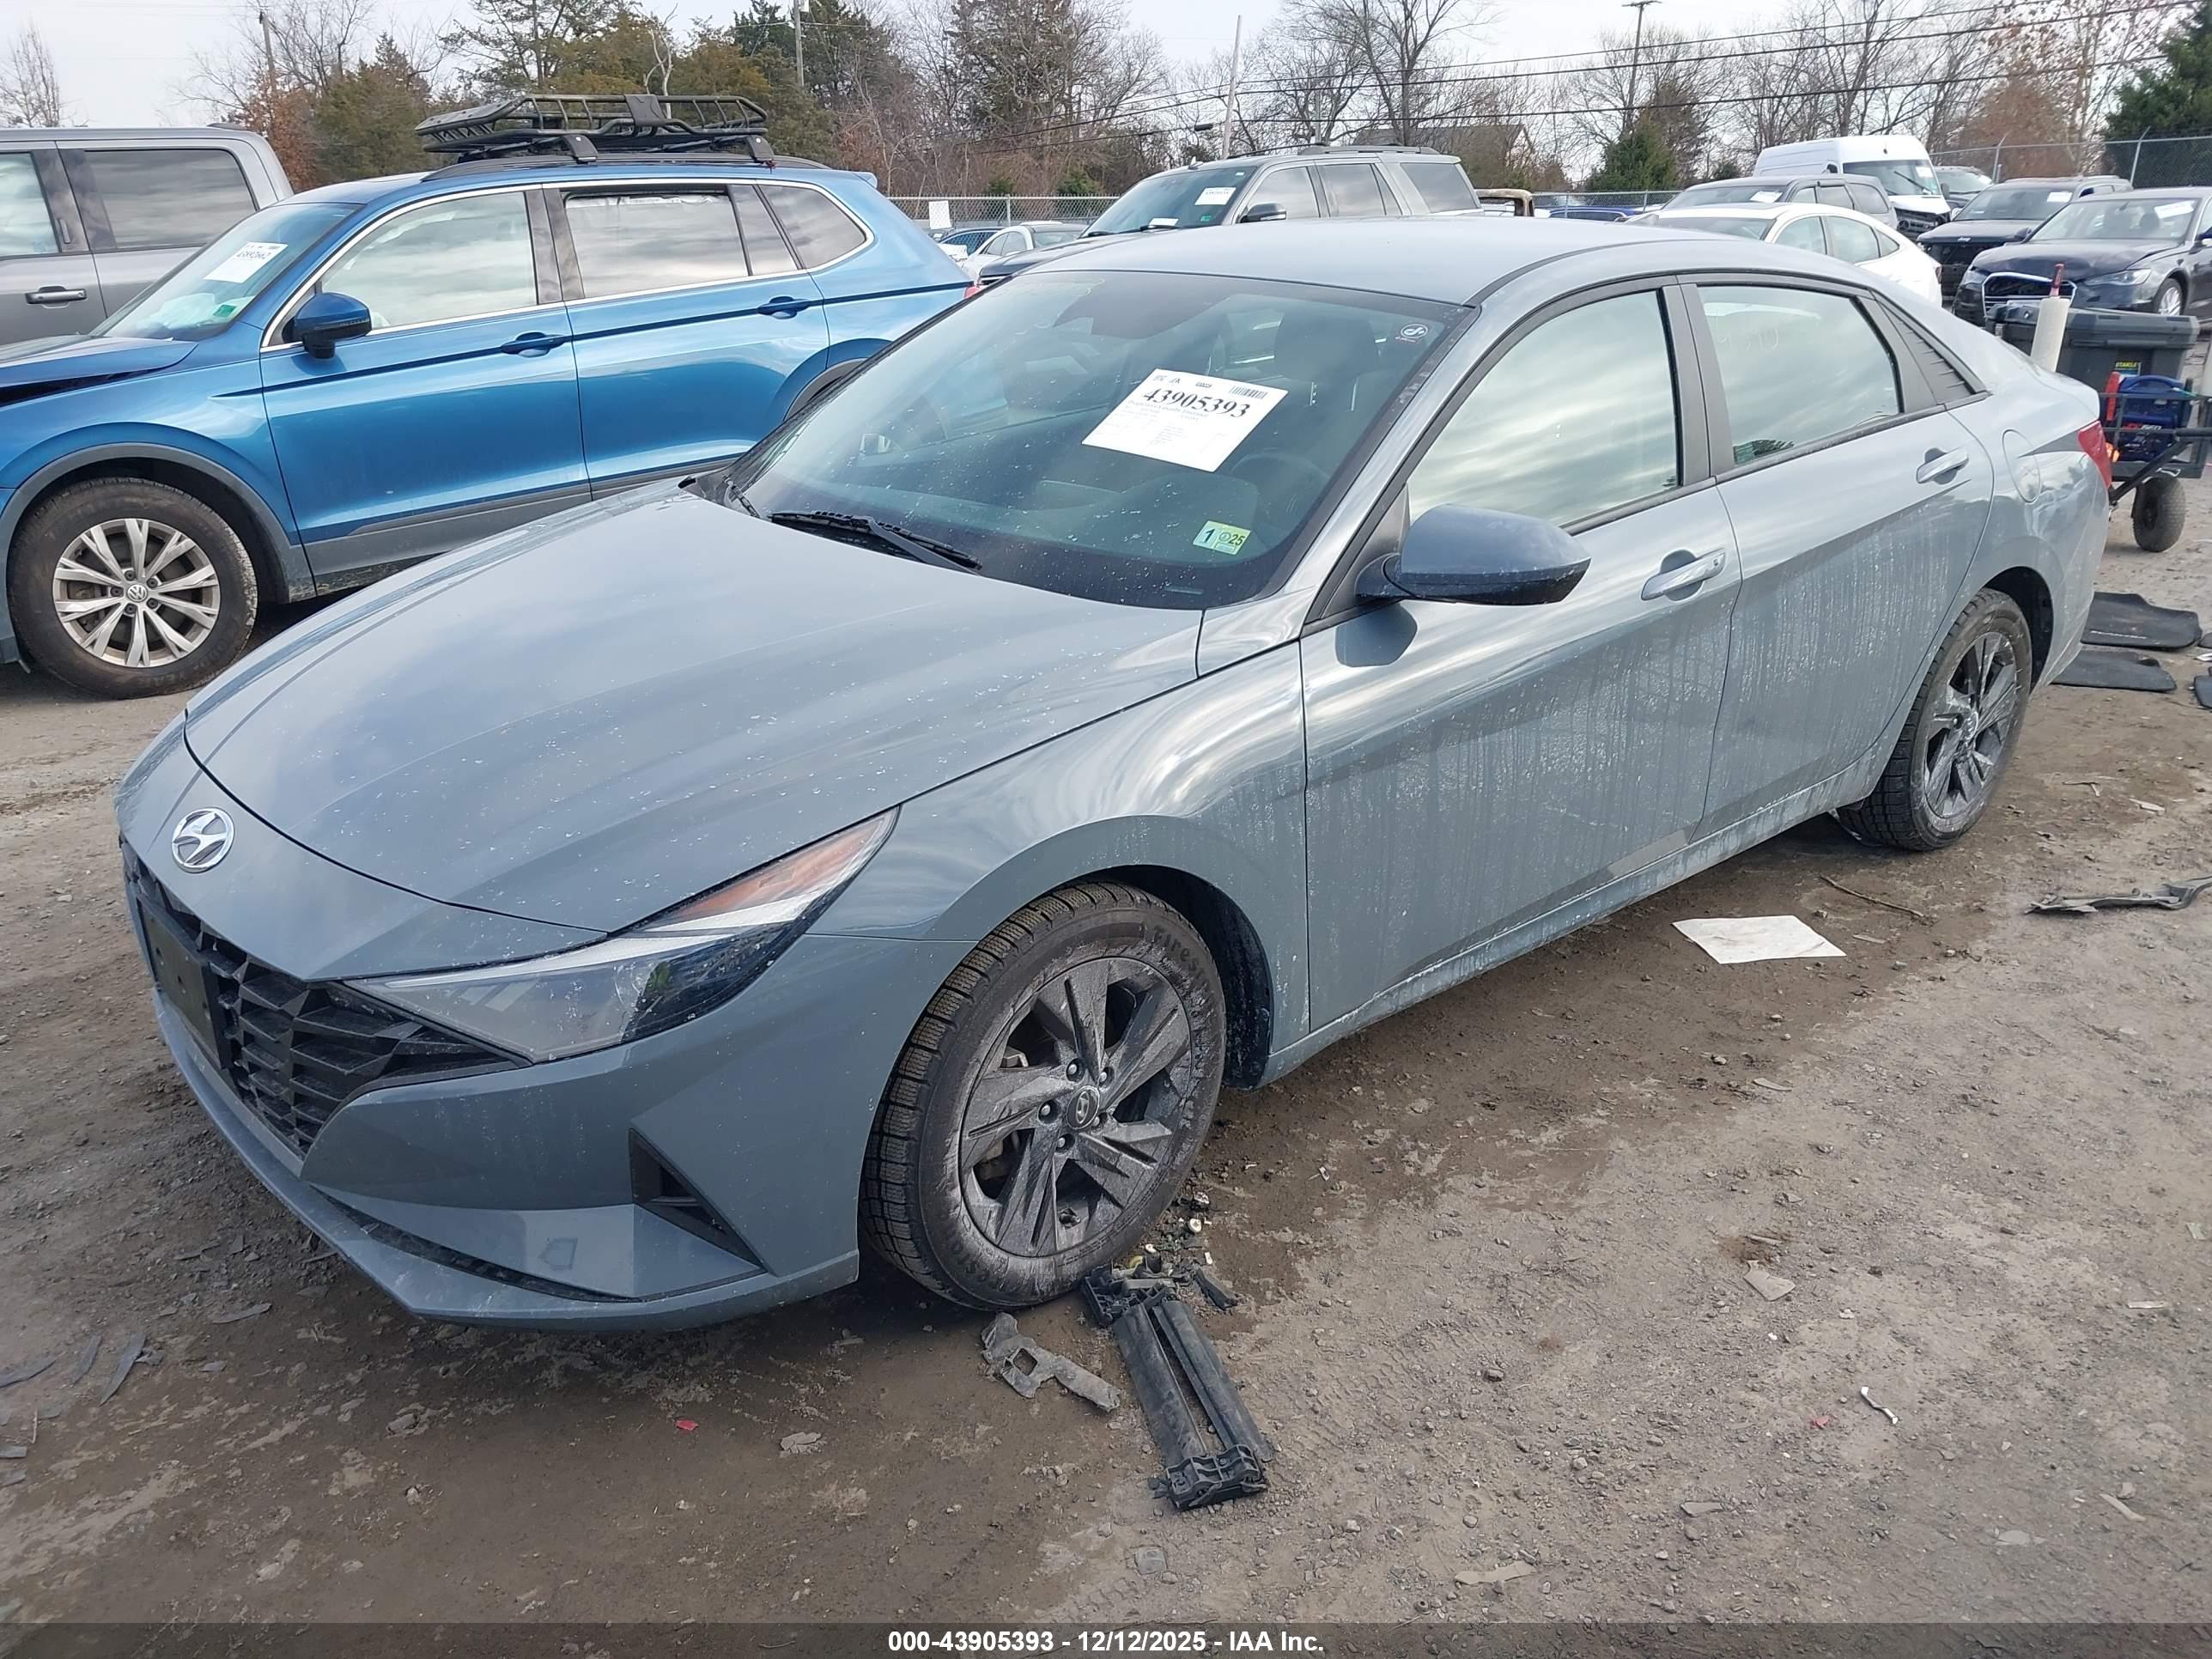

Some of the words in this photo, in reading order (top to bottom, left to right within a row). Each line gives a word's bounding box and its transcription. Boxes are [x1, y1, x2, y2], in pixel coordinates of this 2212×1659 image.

[1143, 388, 1251, 417] 43905393
[1206, 528, 1215, 543] 1
[1228, 533, 1245, 545] 25
